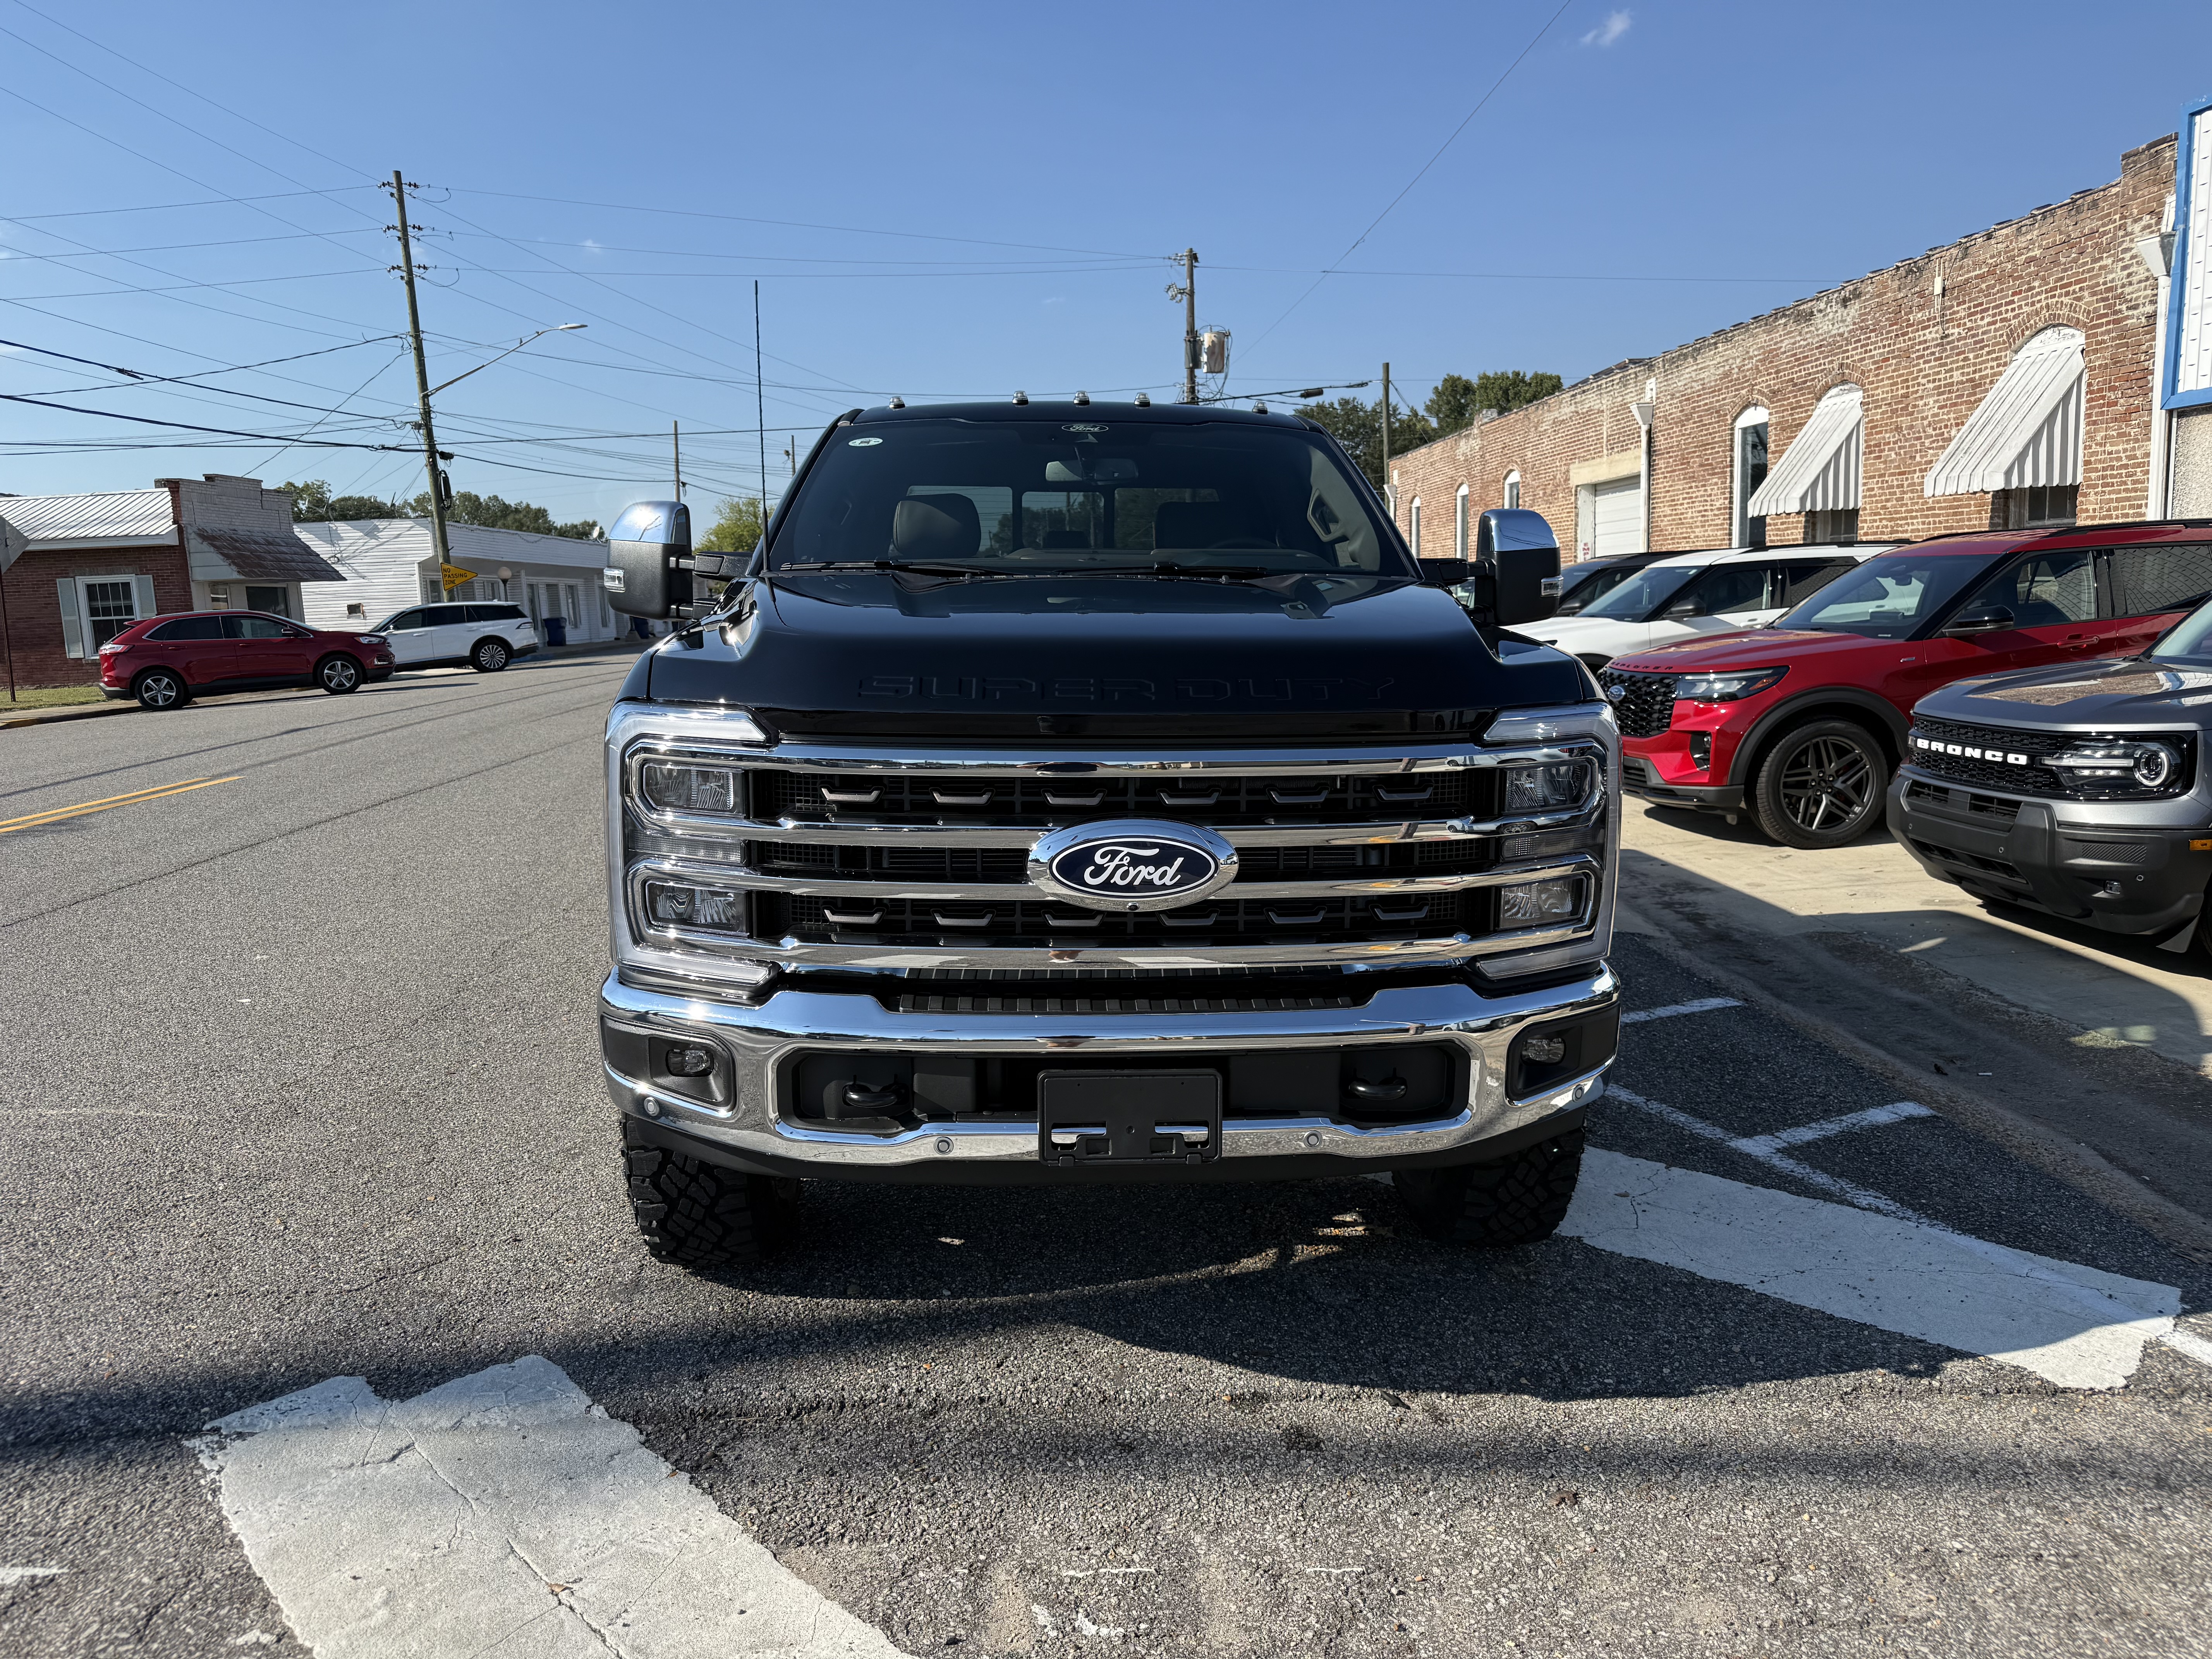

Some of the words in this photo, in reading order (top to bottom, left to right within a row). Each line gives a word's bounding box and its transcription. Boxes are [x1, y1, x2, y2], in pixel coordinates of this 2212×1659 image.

[858, 676, 1156, 701] SUPER
[1175, 677, 1395, 701] DUTY
[1917, 738, 2027, 765] BRONCO
[1084, 846, 1181, 886] Ford
